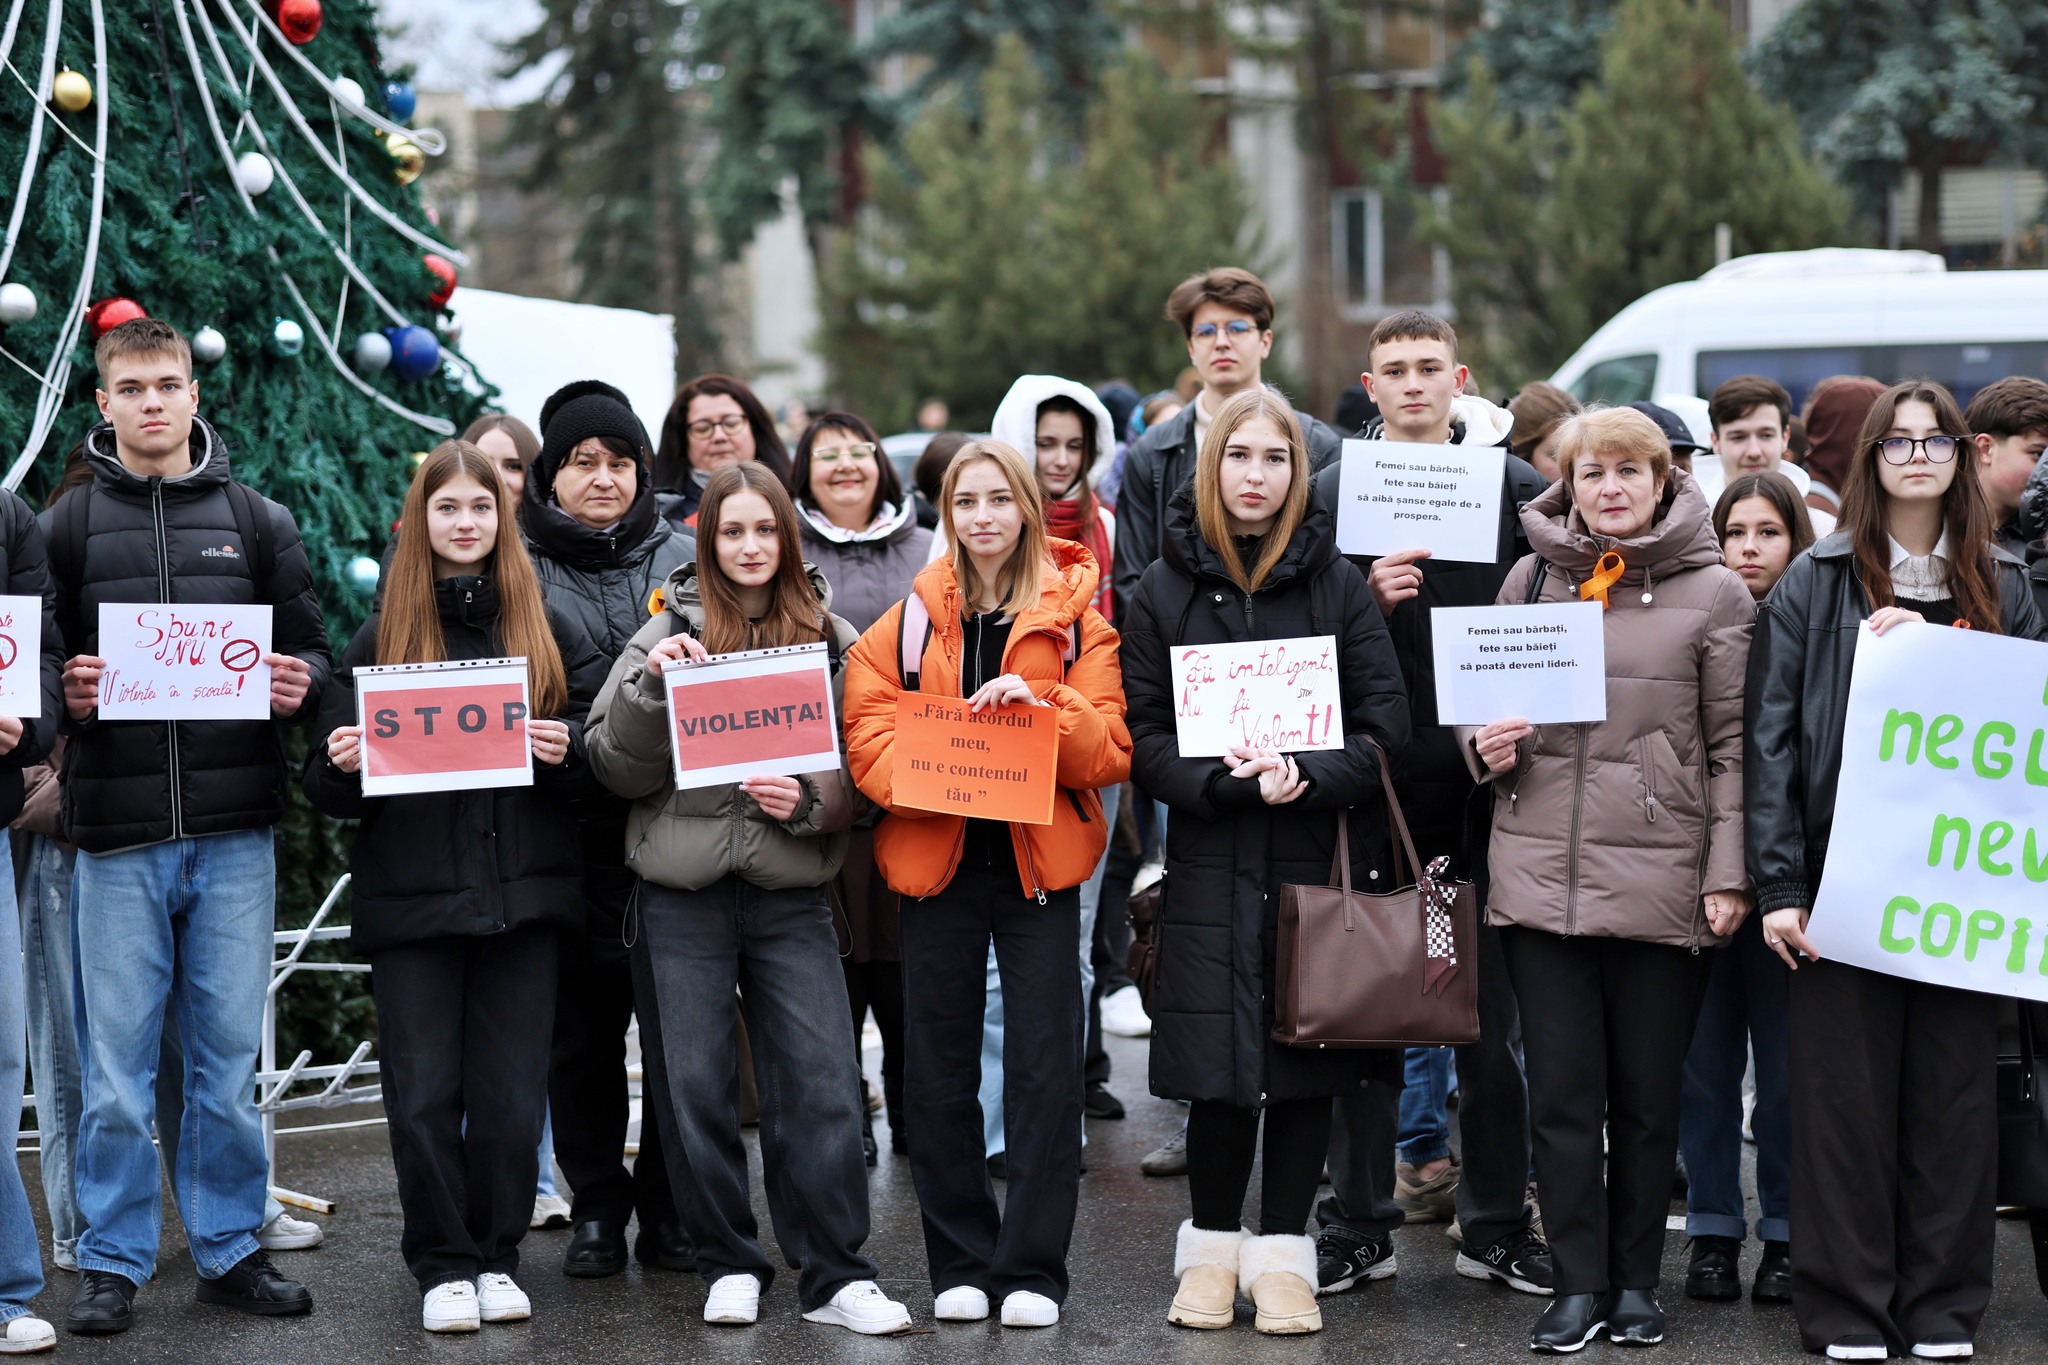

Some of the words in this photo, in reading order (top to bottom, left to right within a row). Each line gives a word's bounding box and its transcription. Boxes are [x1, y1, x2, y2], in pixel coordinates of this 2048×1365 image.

[1375, 460, 1406, 471] Femei
[1408, 464, 1427, 472] sau
[1430, 464, 1469, 475] bărbați,
[1384, 478, 1405, 487] fete
[1407, 480, 1425, 489] sau
[1428, 481, 1457, 492] băieți
[1357, 494, 1369, 502] să
[1371, 494, 1393, 503] aibă
[1396, 497, 1426, 506] șanse
[1428, 499, 1457, 508] egale
[1459, 500, 1472, 509] de
[1394, 512, 1441, 521] prospera.
[201, 547, 240, 559] ellesse
[135, 610, 233, 661] Spune
[1467, 626, 1500, 636] Femei
[1503, 626, 1523, 635] sau
[1525, 624, 1568, 635] bărbați,
[165, 639, 206, 666] NU
[1479, 644, 1501, 653] fete
[1503, 643, 1523, 652] sau
[1526, 642, 1557, 652] băieți
[1226, 645, 1333, 686] inteligent,
[1460, 662, 1473, 671] să
[1475, 661, 1506, 672] poată
[1508, 660, 1545, 670] deveni
[1547, 658, 1578, 669] lideri.
[168, 684, 181, 698] în
[1178, 684, 1204, 717] Nu
[680, 701, 823, 737] VIOLENȚA!
[968, 711, 1033, 728] acordul
[950, 736, 991, 753] meu,
[911, 758, 931, 772] nu
[936, 763, 945, 773] e
[949, 763, 1028, 783] contentul
[946, 787, 972, 803] tău
